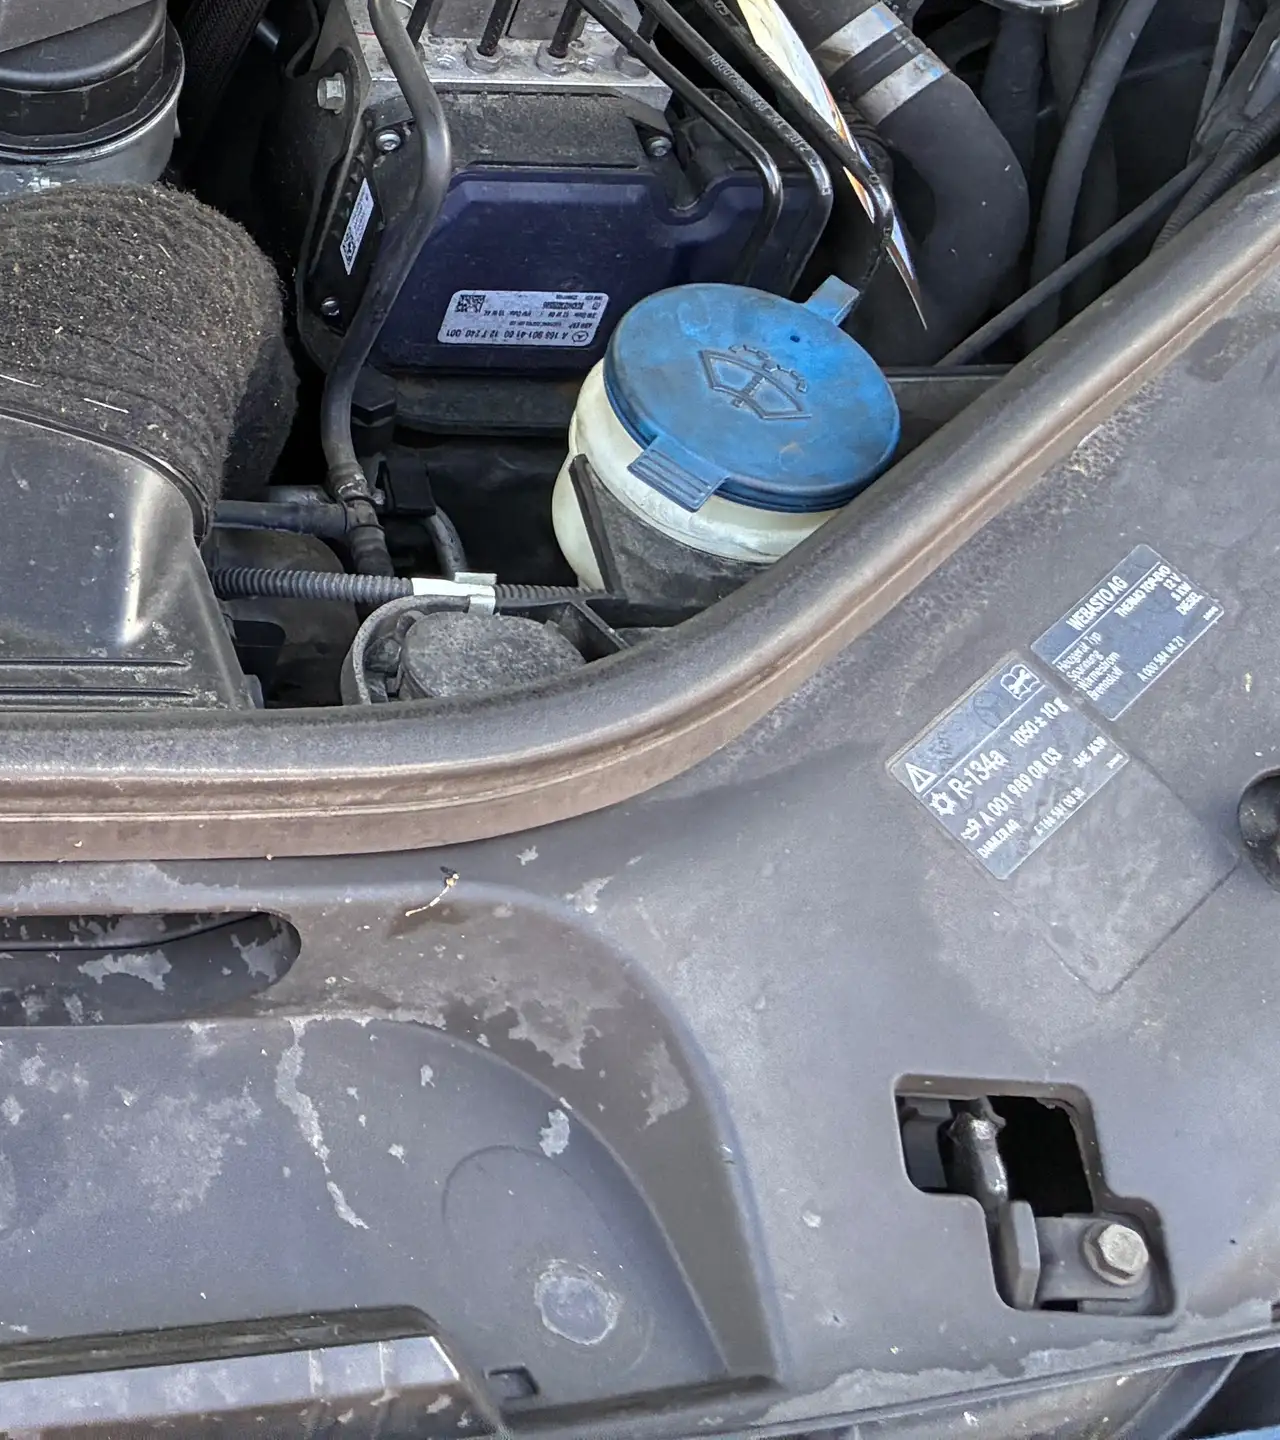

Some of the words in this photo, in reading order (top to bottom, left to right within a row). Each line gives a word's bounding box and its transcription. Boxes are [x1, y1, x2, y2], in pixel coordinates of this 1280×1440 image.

[1169, 572, 1182, 583] V
[1064, 586, 1116, 633] WEBASTO
[1105, 574, 1129, 595] AG
[1175, 589, 1204, 616] DIESEL
[946, 743, 1008, 801] R-134a
[1008, 718, 1041, 749] 1050
[1038, 700, 1060, 721] 10
[1051, 696, 1071, 714] g
[1039, 745, 1063, 767] 03
[1071, 749, 1092, 769] SAE
[1025, 758, 1049, 781] 08
[1006, 771, 1036, 799] 989
[976, 808, 996, 827] A
[985, 790, 1015, 818] 001
[976, 826, 1011, 860] DAIMLER
[1003, 817, 1021, 835] AG
